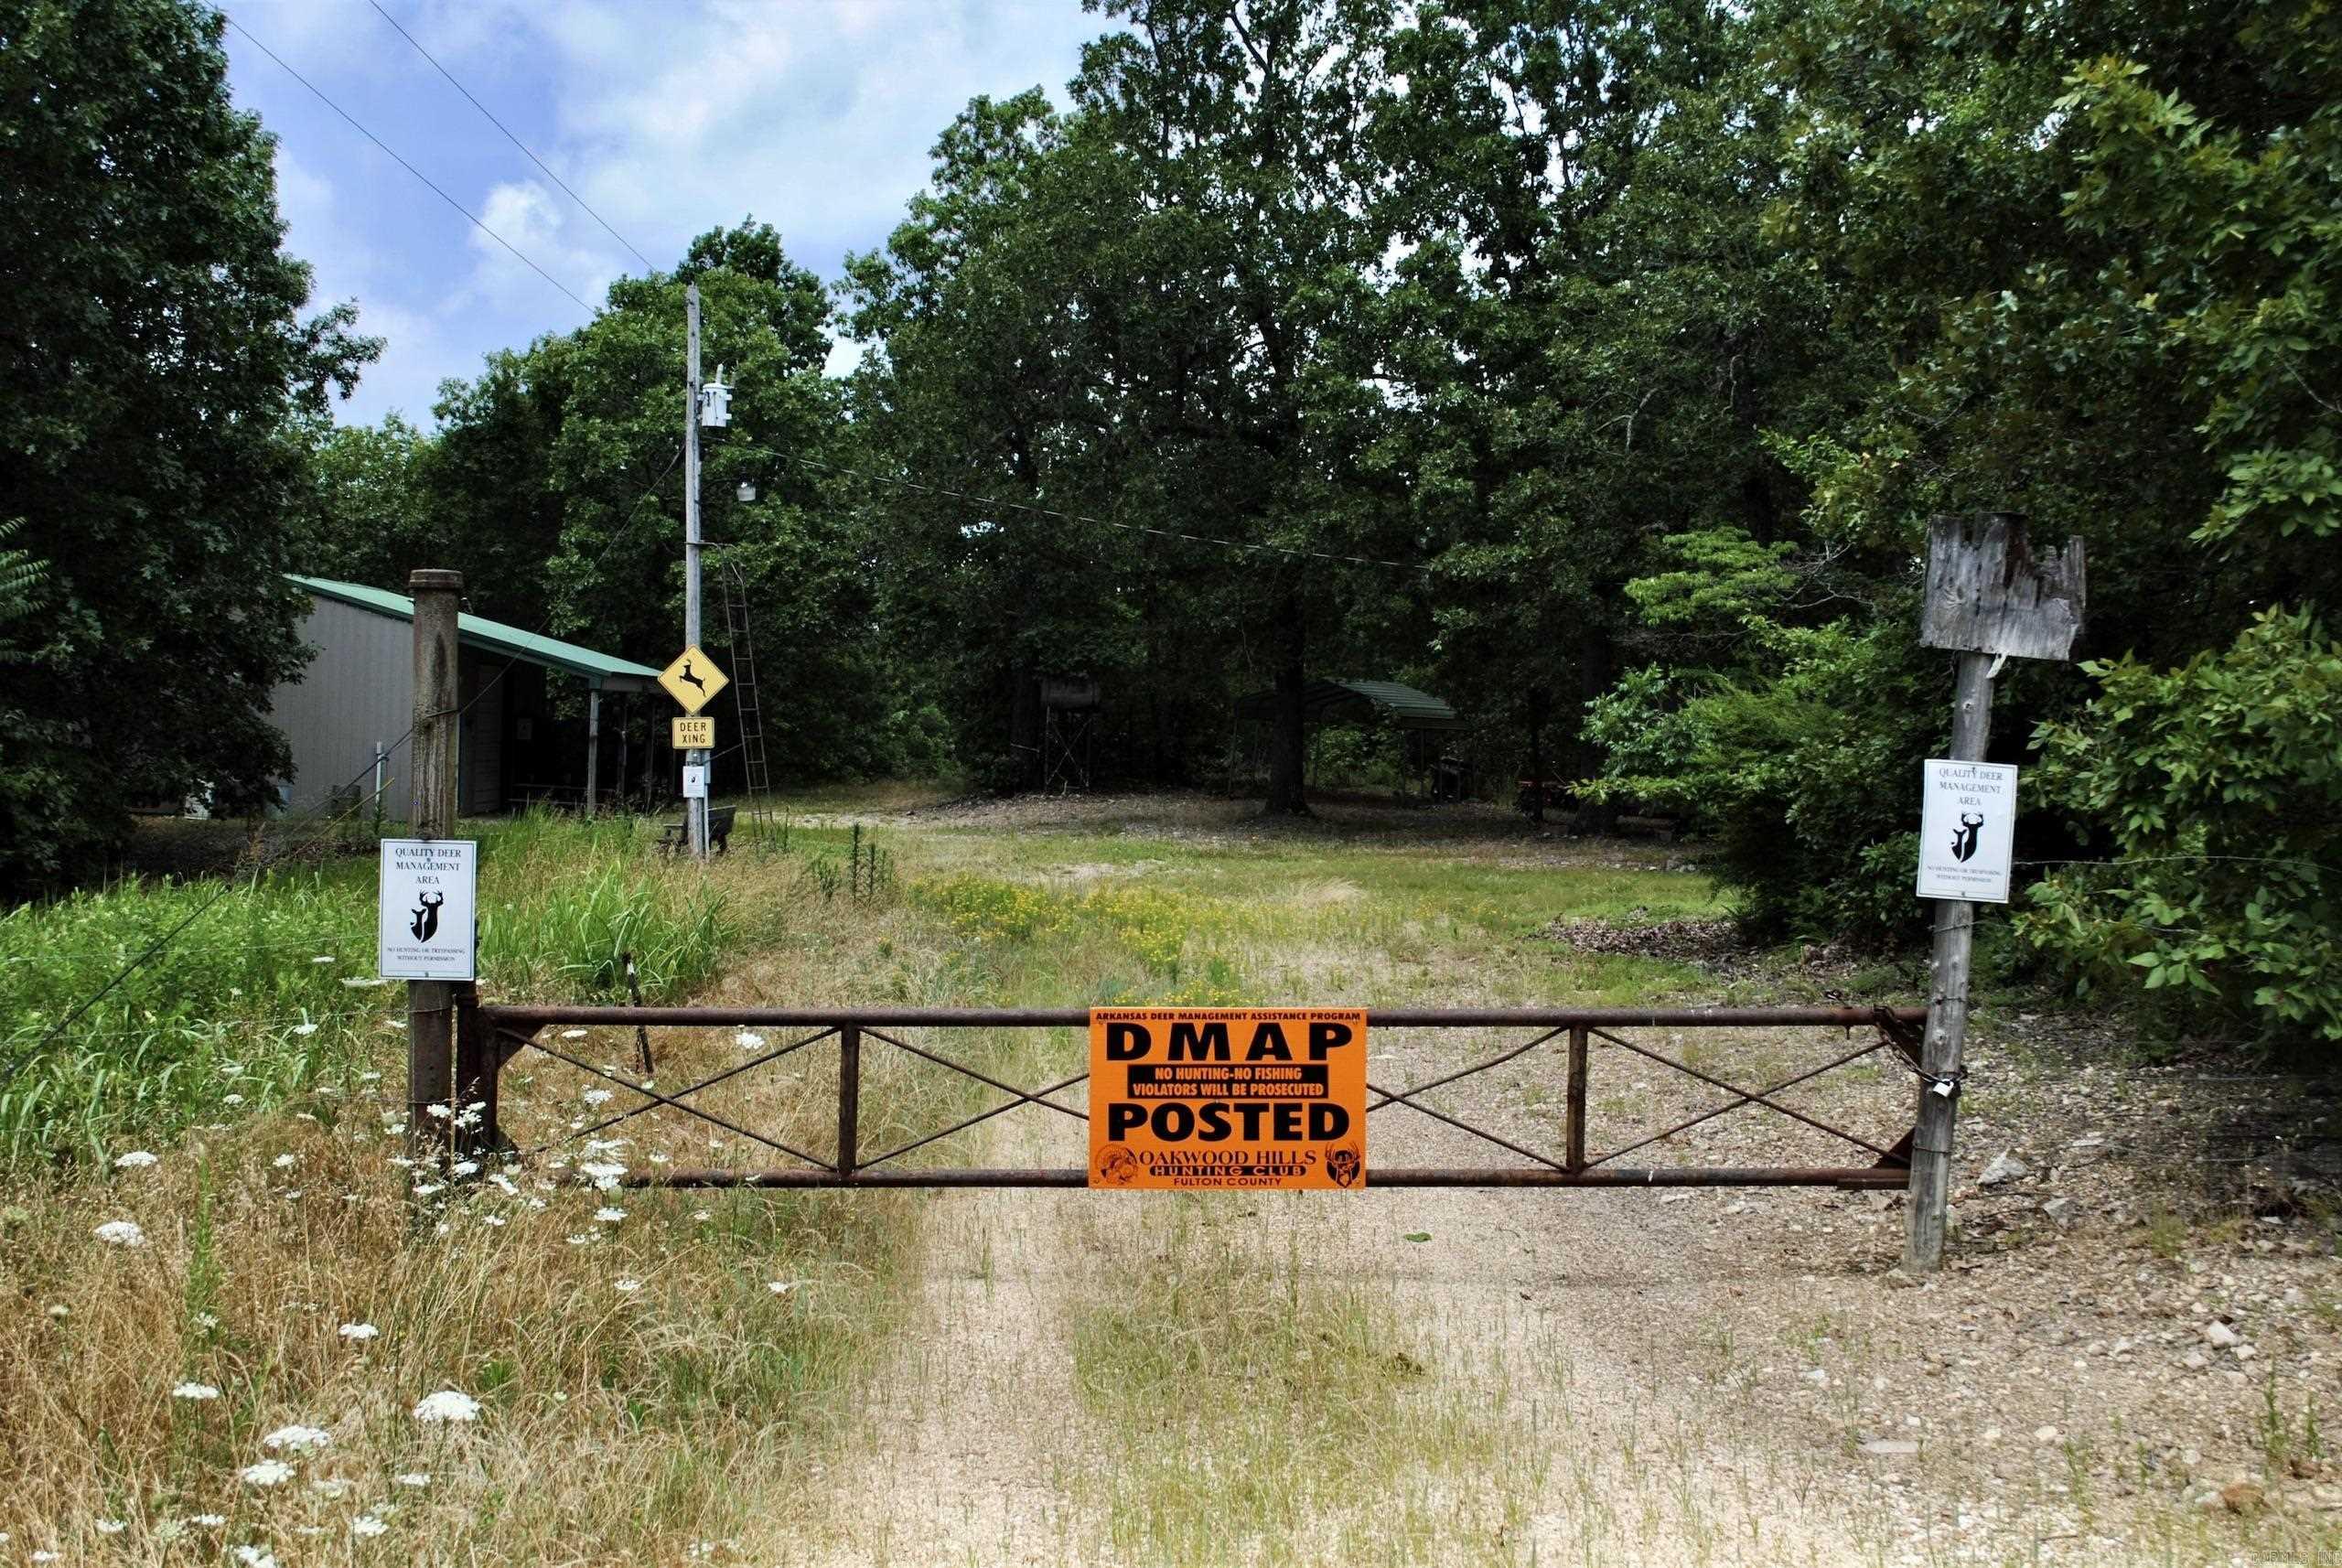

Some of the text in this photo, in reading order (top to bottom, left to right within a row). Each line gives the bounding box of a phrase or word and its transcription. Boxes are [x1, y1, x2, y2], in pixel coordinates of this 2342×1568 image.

[680, 722, 707, 732] DEER
[682, 734, 706, 744] XING
[1939, 768, 2004, 781] QUALITY DEER
[1939, 781, 2002, 793] MANAGEMENT
[1959, 797, 1982, 806] AREA
[395, 847, 461, 859] QUALITY DEER
[395, 862, 461, 871] MANAGEMENT
[415, 875, 440, 885] AREA
[1096, 1012, 1360, 1020] ARKANSAS DEER MANAGEMENT ASSISTANCE PROGRAM
[1155, 1067, 1174, 1080] NO
[1254, 1067, 1303, 1080] FISHING
[1133, 1083, 1324, 1096] VIOLATORS WILL BE PROSECUTED
[1107, 1101, 1350, 1143] POSTED
[1138, 1149, 1317, 1165] OAKWOOD HILLS
[1154, 1165, 1303, 1176] HUNTING CLUB
[1173, 1177, 1283, 1187] FULTON COUNTY
